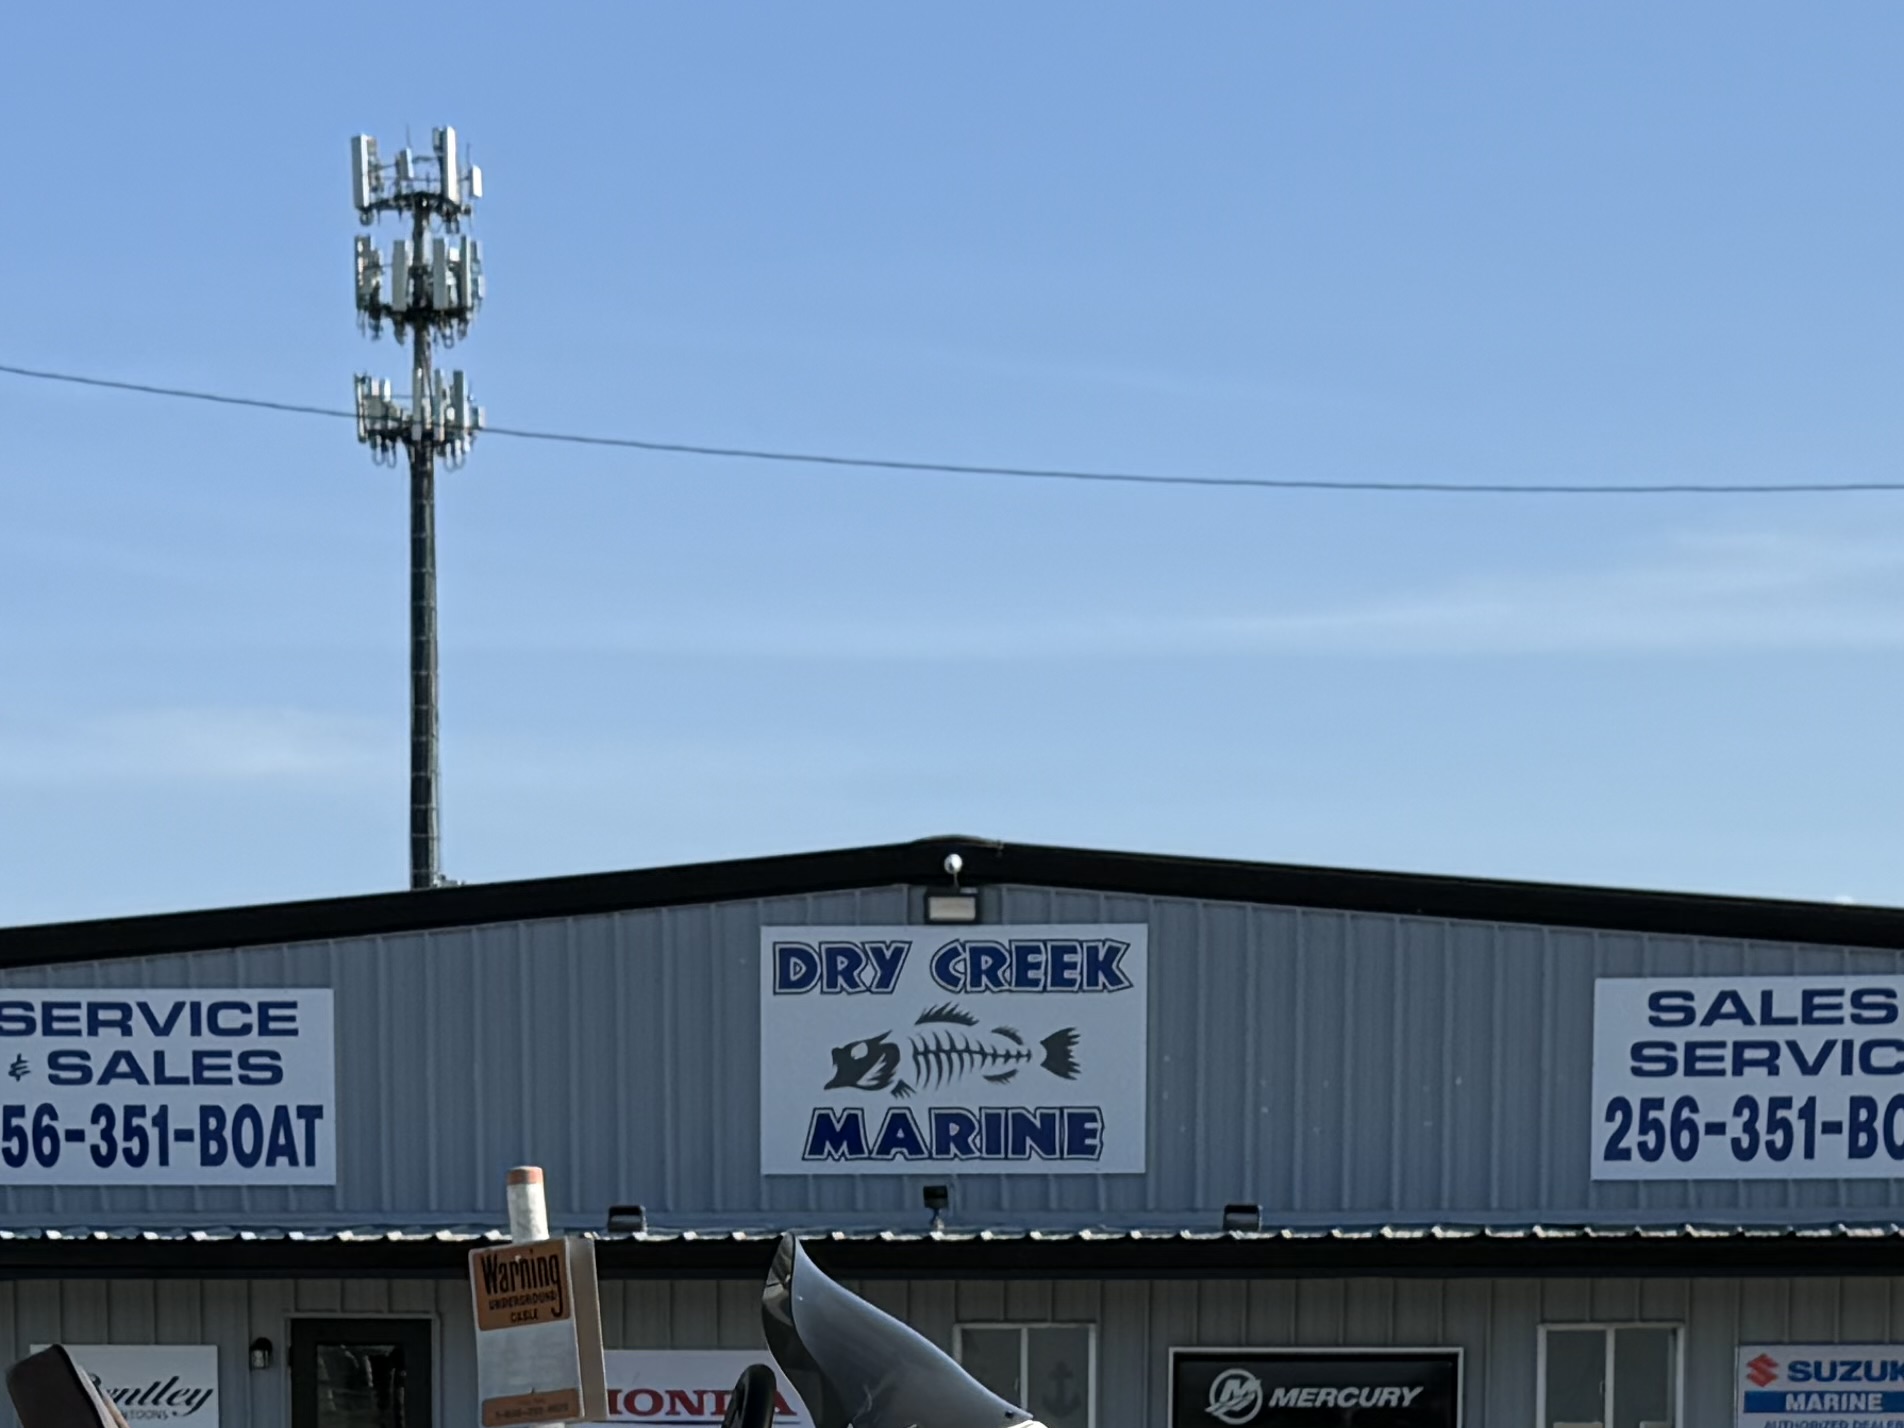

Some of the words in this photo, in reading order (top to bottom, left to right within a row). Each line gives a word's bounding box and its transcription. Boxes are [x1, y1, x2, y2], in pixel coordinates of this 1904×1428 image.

[773, 940, 912, 995] DRY
[930, 938, 1134, 994] CREEK
[1647, 987, 1900, 1028] SALES
[47, 1049, 284, 1086] SALES
[802, 1106, 1105, 1162] MARINE
[480, 1250, 564, 1318] Warning
[121, 1409, 168, 1420] TOONS
[607, 1388, 798, 1416] ONA
[1268, 1386, 1425, 1408] MERCURY
[1785, 1393, 1883, 1411] MARINE
